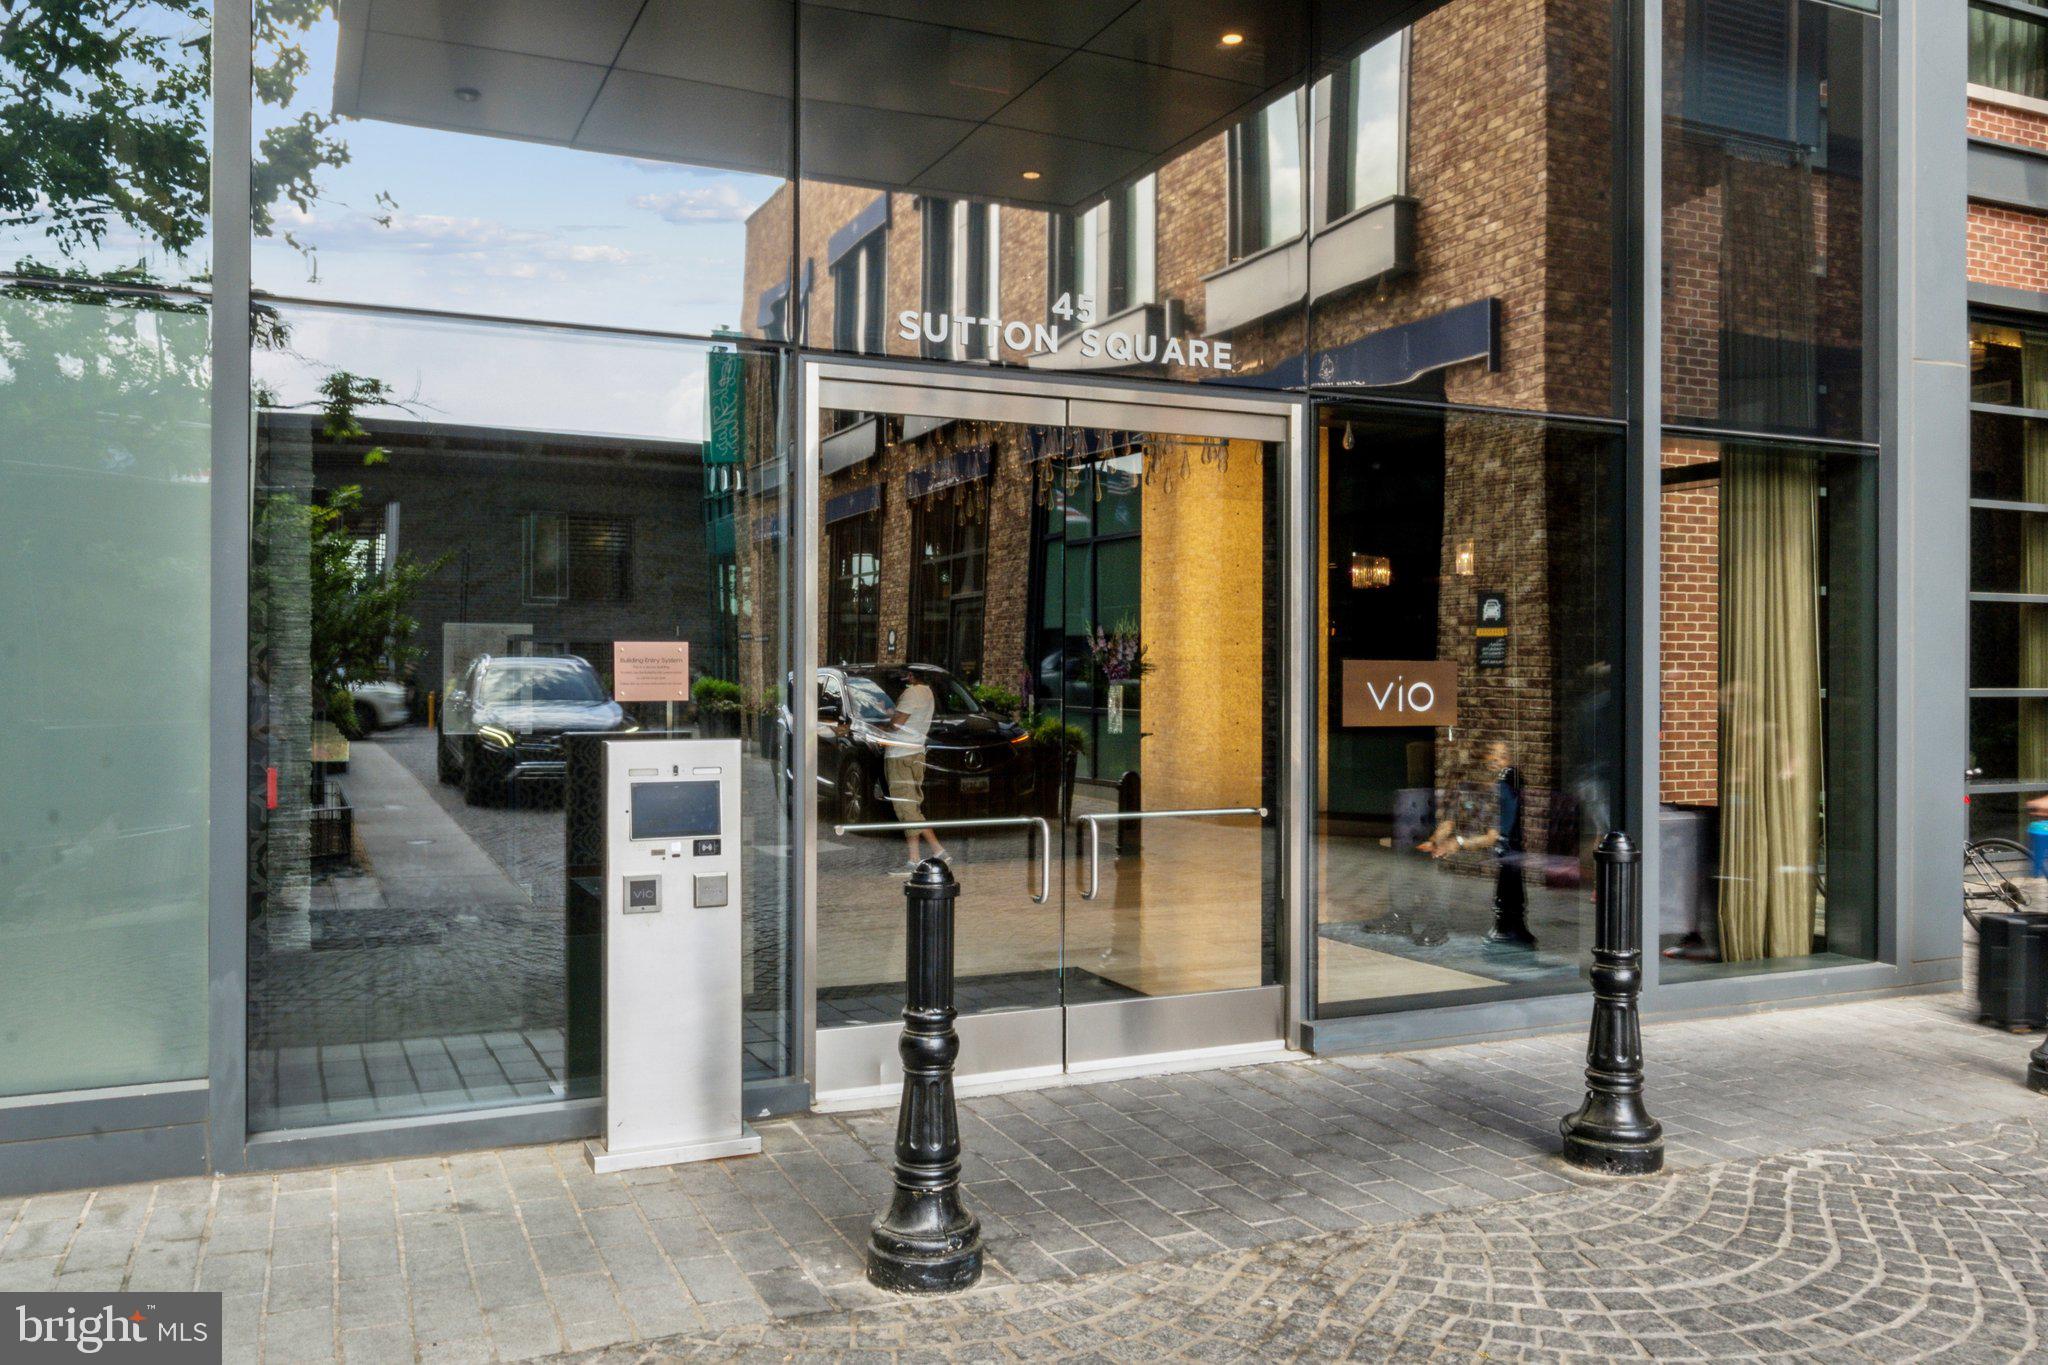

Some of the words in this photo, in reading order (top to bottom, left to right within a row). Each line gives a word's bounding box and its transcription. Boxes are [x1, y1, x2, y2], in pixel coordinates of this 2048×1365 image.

[1051, 292, 1095, 323] 45
[898, 310, 1058, 353] SUTTON
[1081, 330, 1232, 370] SQUARE
[1366, 675, 1434, 712] vio
